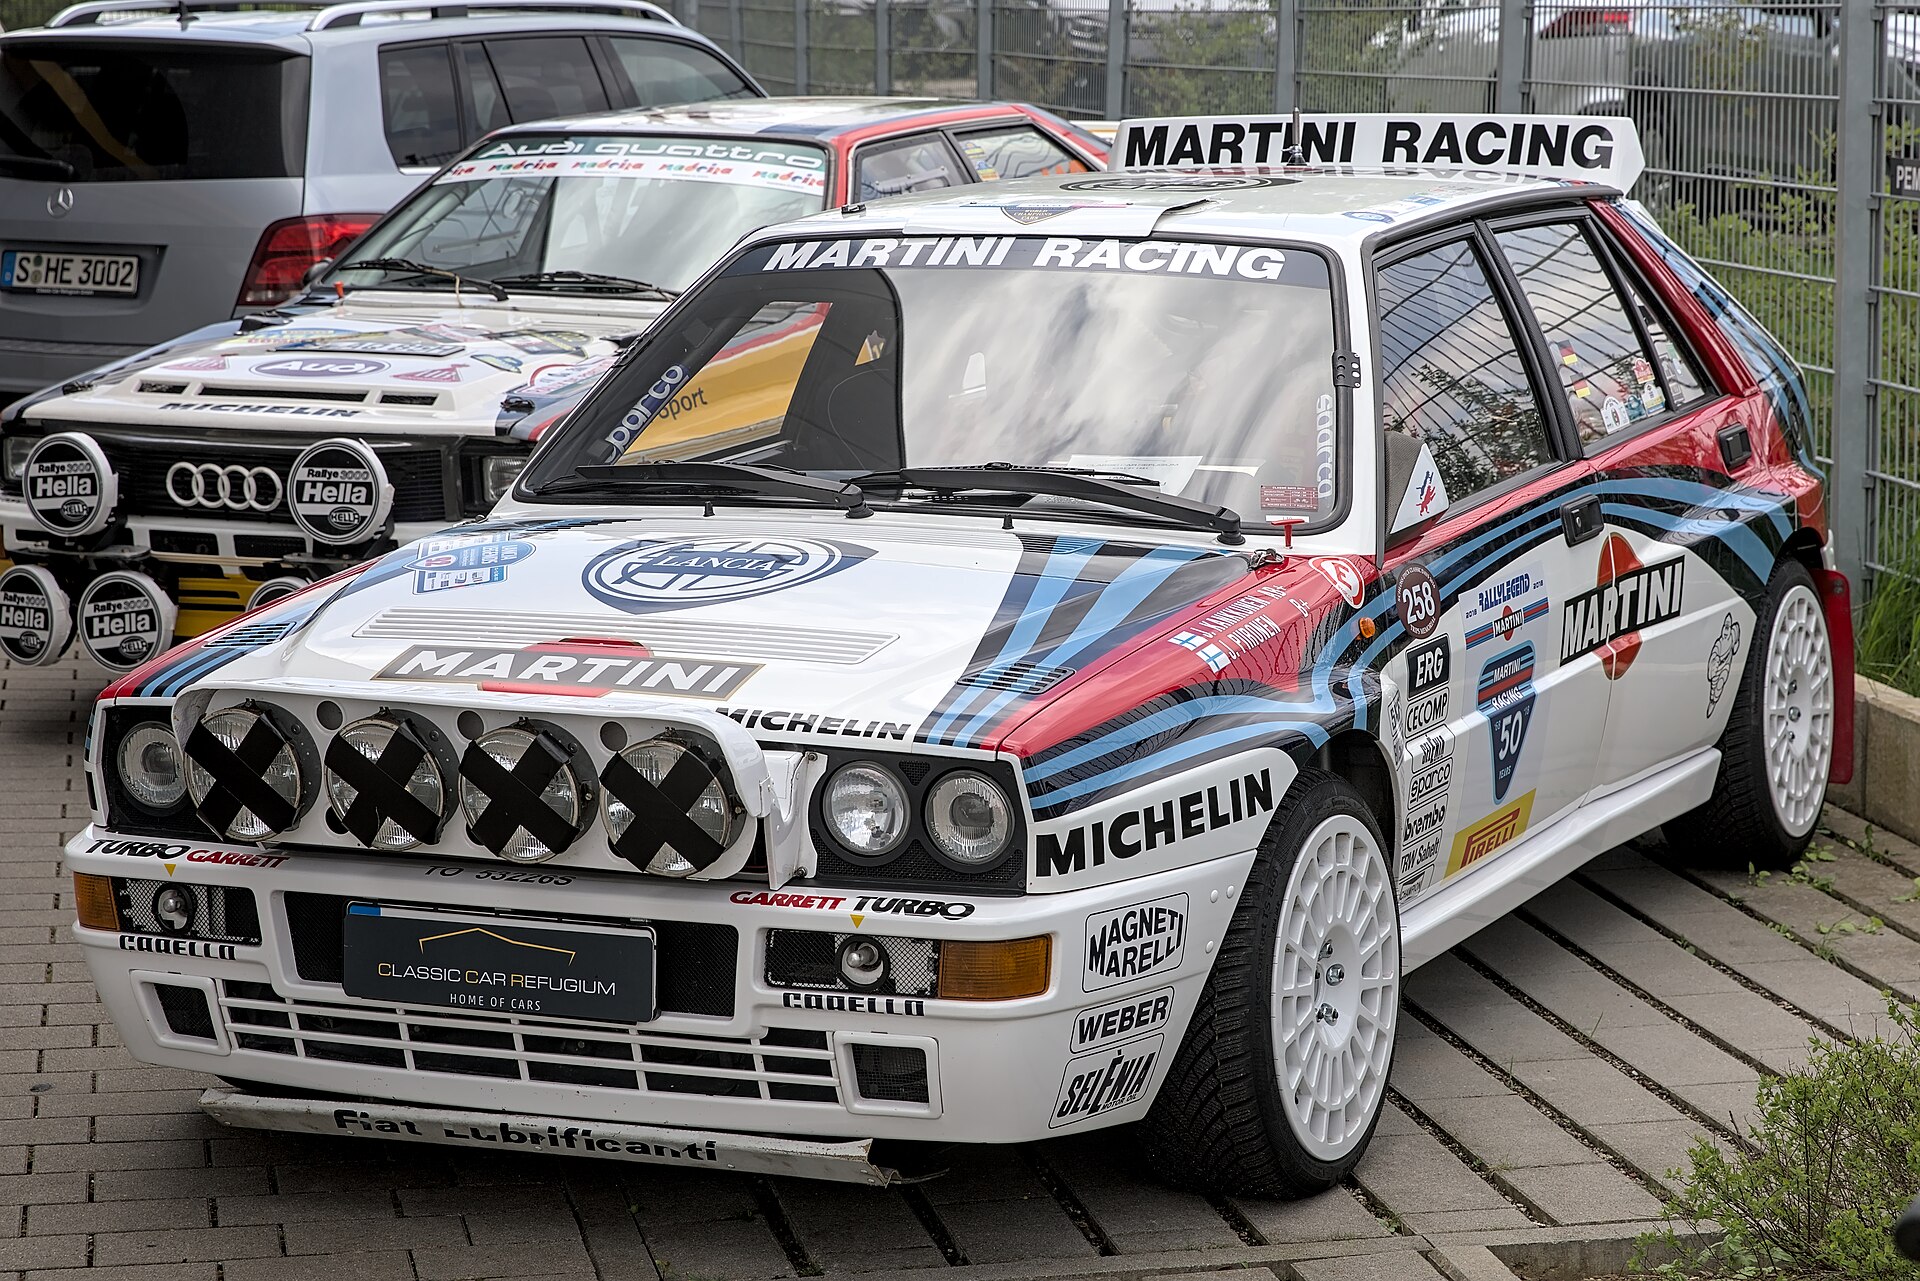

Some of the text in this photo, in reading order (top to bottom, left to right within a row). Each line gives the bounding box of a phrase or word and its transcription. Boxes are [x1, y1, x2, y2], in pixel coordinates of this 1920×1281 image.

[478, 140, 823, 169] Audi quattro
[1124, 121, 1616, 169] MARTINI RACING
[16, 257, 134, 286] S HE 3002
[762, 236, 1287, 281] MARTINI RACING
[159, 402, 360, 418] MICHELIN
[38, 463, 92, 474] Rallye 3000
[307, 469, 369, 480] Rallye 3000
[36, 475, 92, 497] Hella
[302, 482, 367, 503] Hella
[653, 556, 776, 570] LANCIA
[3, 592, 46, 607] Rallye 3000
[93, 598, 149, 613] Rallye 3000
[1403, 581, 1436, 624] 258
[1478, 573, 1530, 612] RALLYLEGEND
[1, 606, 45, 629] Hella
[92, 613, 150, 637] Hella
[1494, 611, 1523, 635] MARTINI
[1562, 562, 1683, 660] MARTINI
[394, 650, 744, 694] MARTINI
[1415, 647, 1444, 688] ERG
[1493, 657, 1521, 683] MARTINI
[1407, 692, 1448, 732] CECOMP
[1491, 686, 1523, 710] RACING
[715, 708, 911, 740] MICHELIN
[1499, 710, 1523, 760] 50
[1411, 764, 1450, 802] sparco
[1036, 768, 1274, 877] MICHELIN
[1404, 804, 1445, 842] brembo
[1417, 837, 1439, 866] Sabelt
[1460, 807, 1520, 869] PIRELLI
[86, 839, 290, 868] TURBO GARRETT
[425, 866, 464, 877] TO
[730, 891, 975, 920] GARRETT TURBO
[377, 963, 616, 996] CLASSIC CAR REFUGIUM
[450, 993, 541, 1011] HOME OF CARS
[1079, 995, 1169, 1044] WEBER
[333, 1108, 717, 1162] Fiat Lubrificanti
